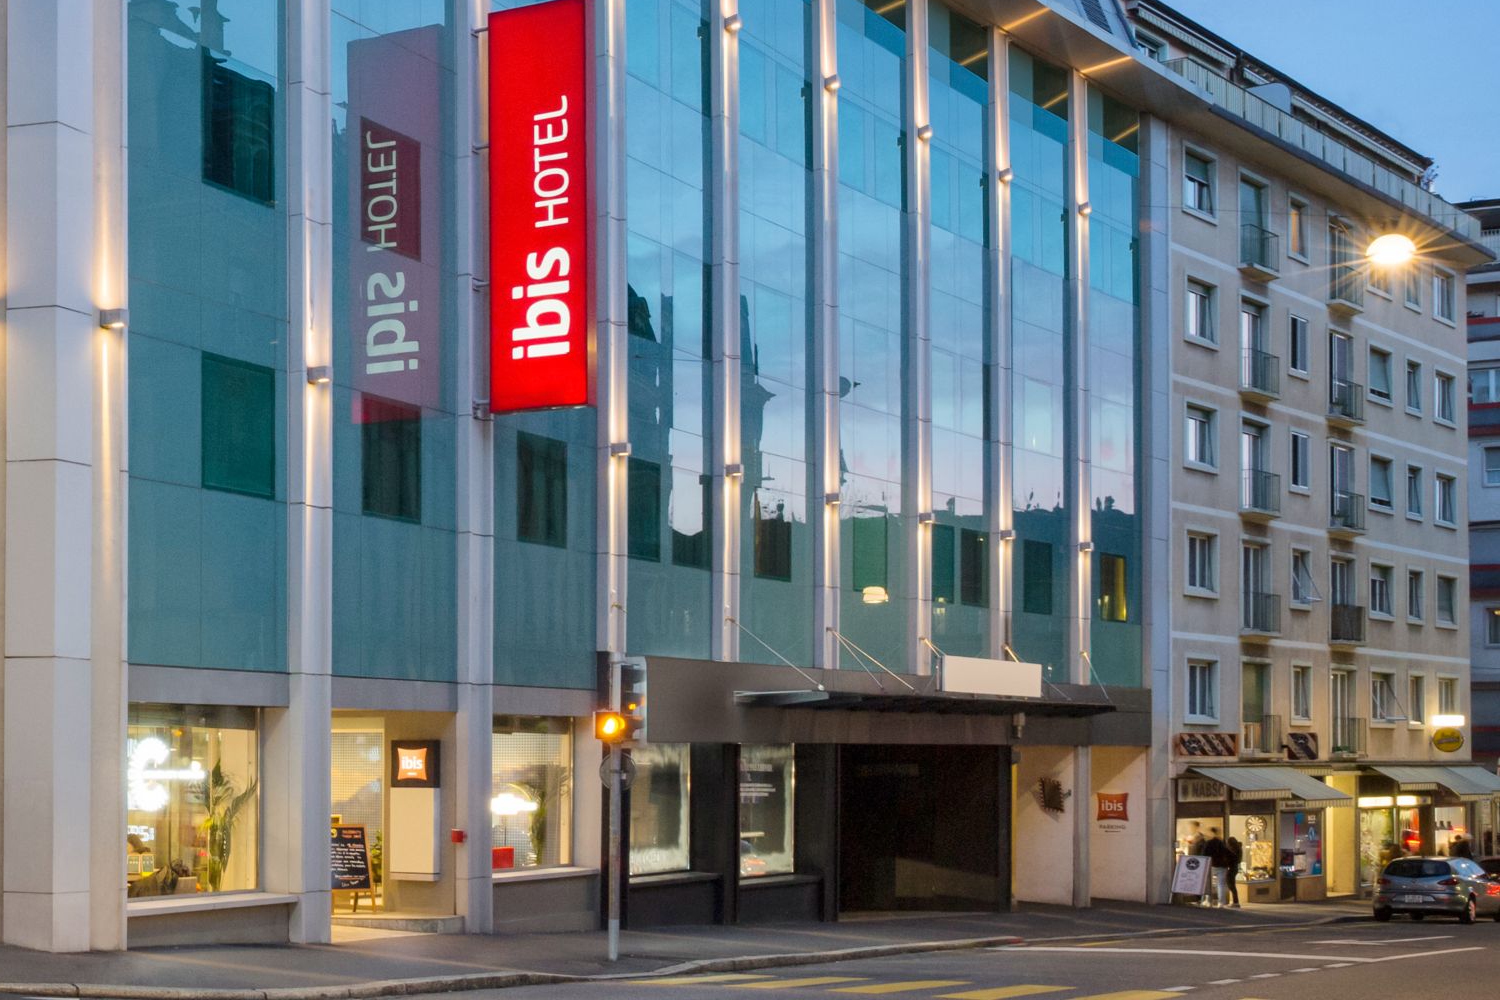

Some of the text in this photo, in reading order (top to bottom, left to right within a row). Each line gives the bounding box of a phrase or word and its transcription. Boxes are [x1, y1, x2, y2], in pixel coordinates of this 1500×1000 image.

[511, 95, 571, 360] ibis HOTEL
[401, 755, 423, 770] ibis
[1101, 799, 1124, 811] ibis
